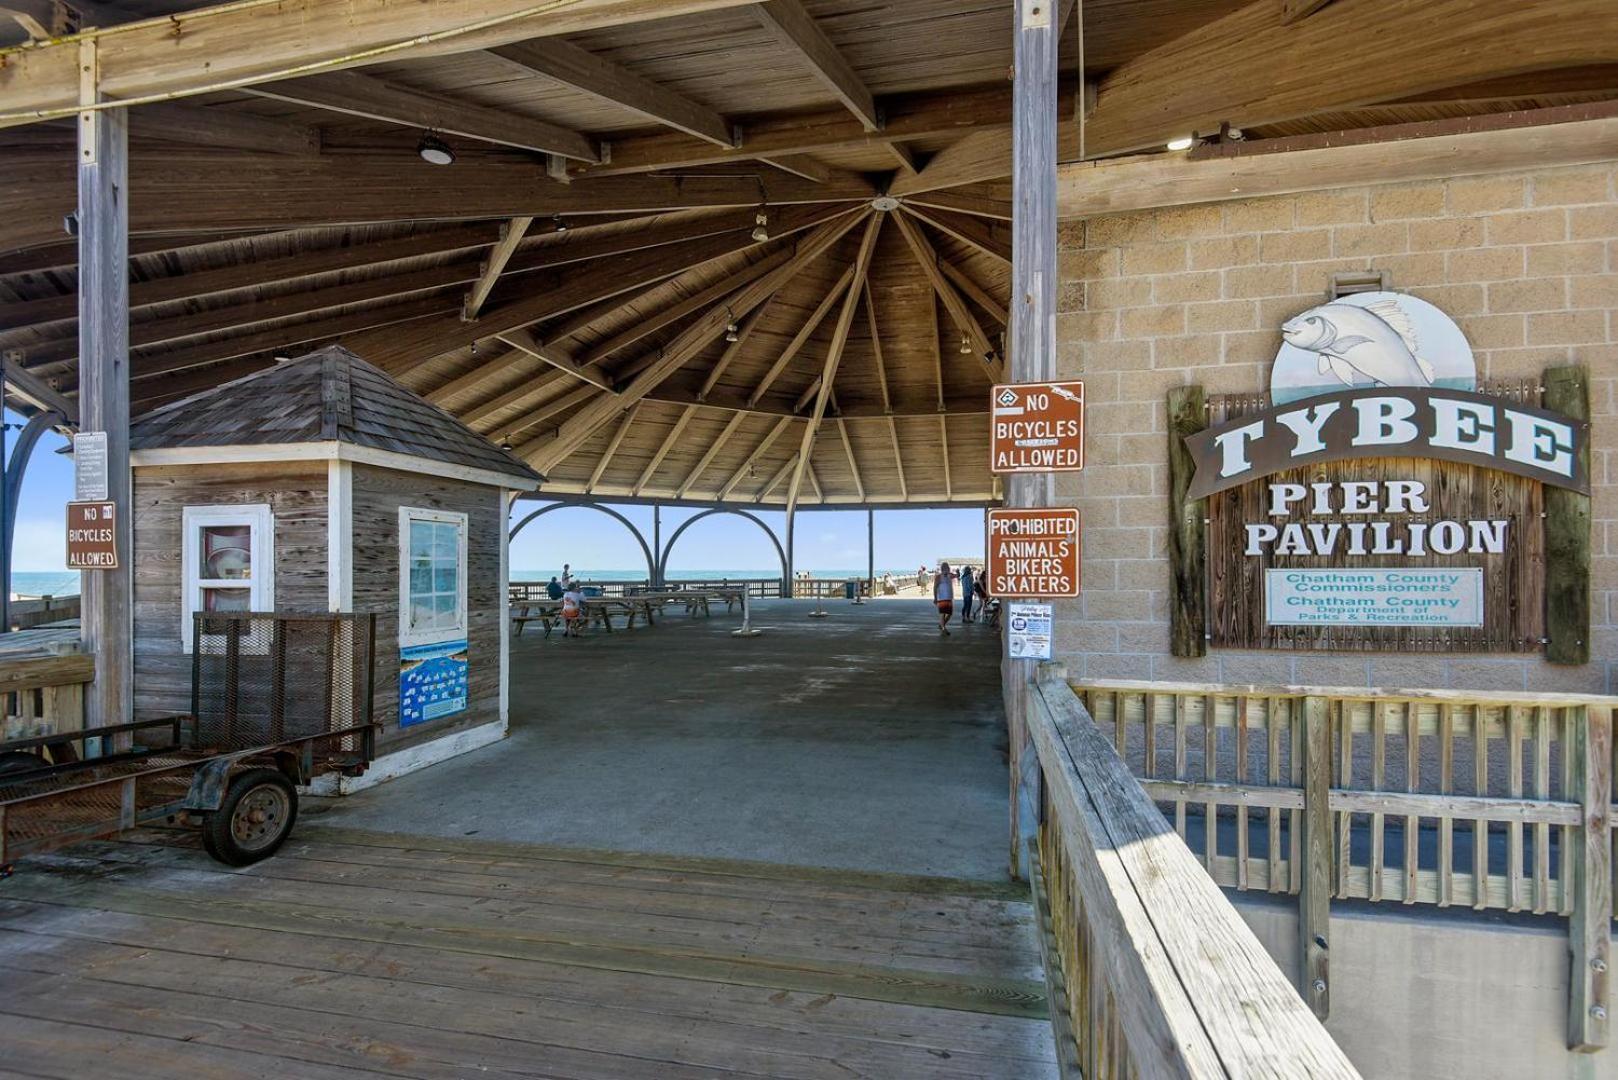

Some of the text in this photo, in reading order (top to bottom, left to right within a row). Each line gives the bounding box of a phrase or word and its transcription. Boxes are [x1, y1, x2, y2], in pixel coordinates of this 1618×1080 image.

[1026, 394, 1049, 411] NO
[997, 420, 1078, 439] BICYCLES
[1214, 396, 1573, 479] TYBEE
[997, 449, 1078, 467] ALLOWED
[1268, 480, 1430, 516] PIER
[84, 507, 97, 520] NO
[991, 518, 1076, 535] PROHIBITED
[69, 529, 112, 542] BICYCLES
[1244, 519, 1508, 557] PAVILION
[998, 541, 1069, 558] ANIMALS
[70, 552, 114, 565] ALLOWED
[1006, 558, 1062, 575] BIKERS
[996, 576, 1070, 593] SKATERS
[1286, 574, 1460, 584] Chatham County
[1295, 583, 1451, 592] Commissioners
[1286, 597, 1460, 607] Chatham County
[1367, 613, 1448, 621] Recreation
